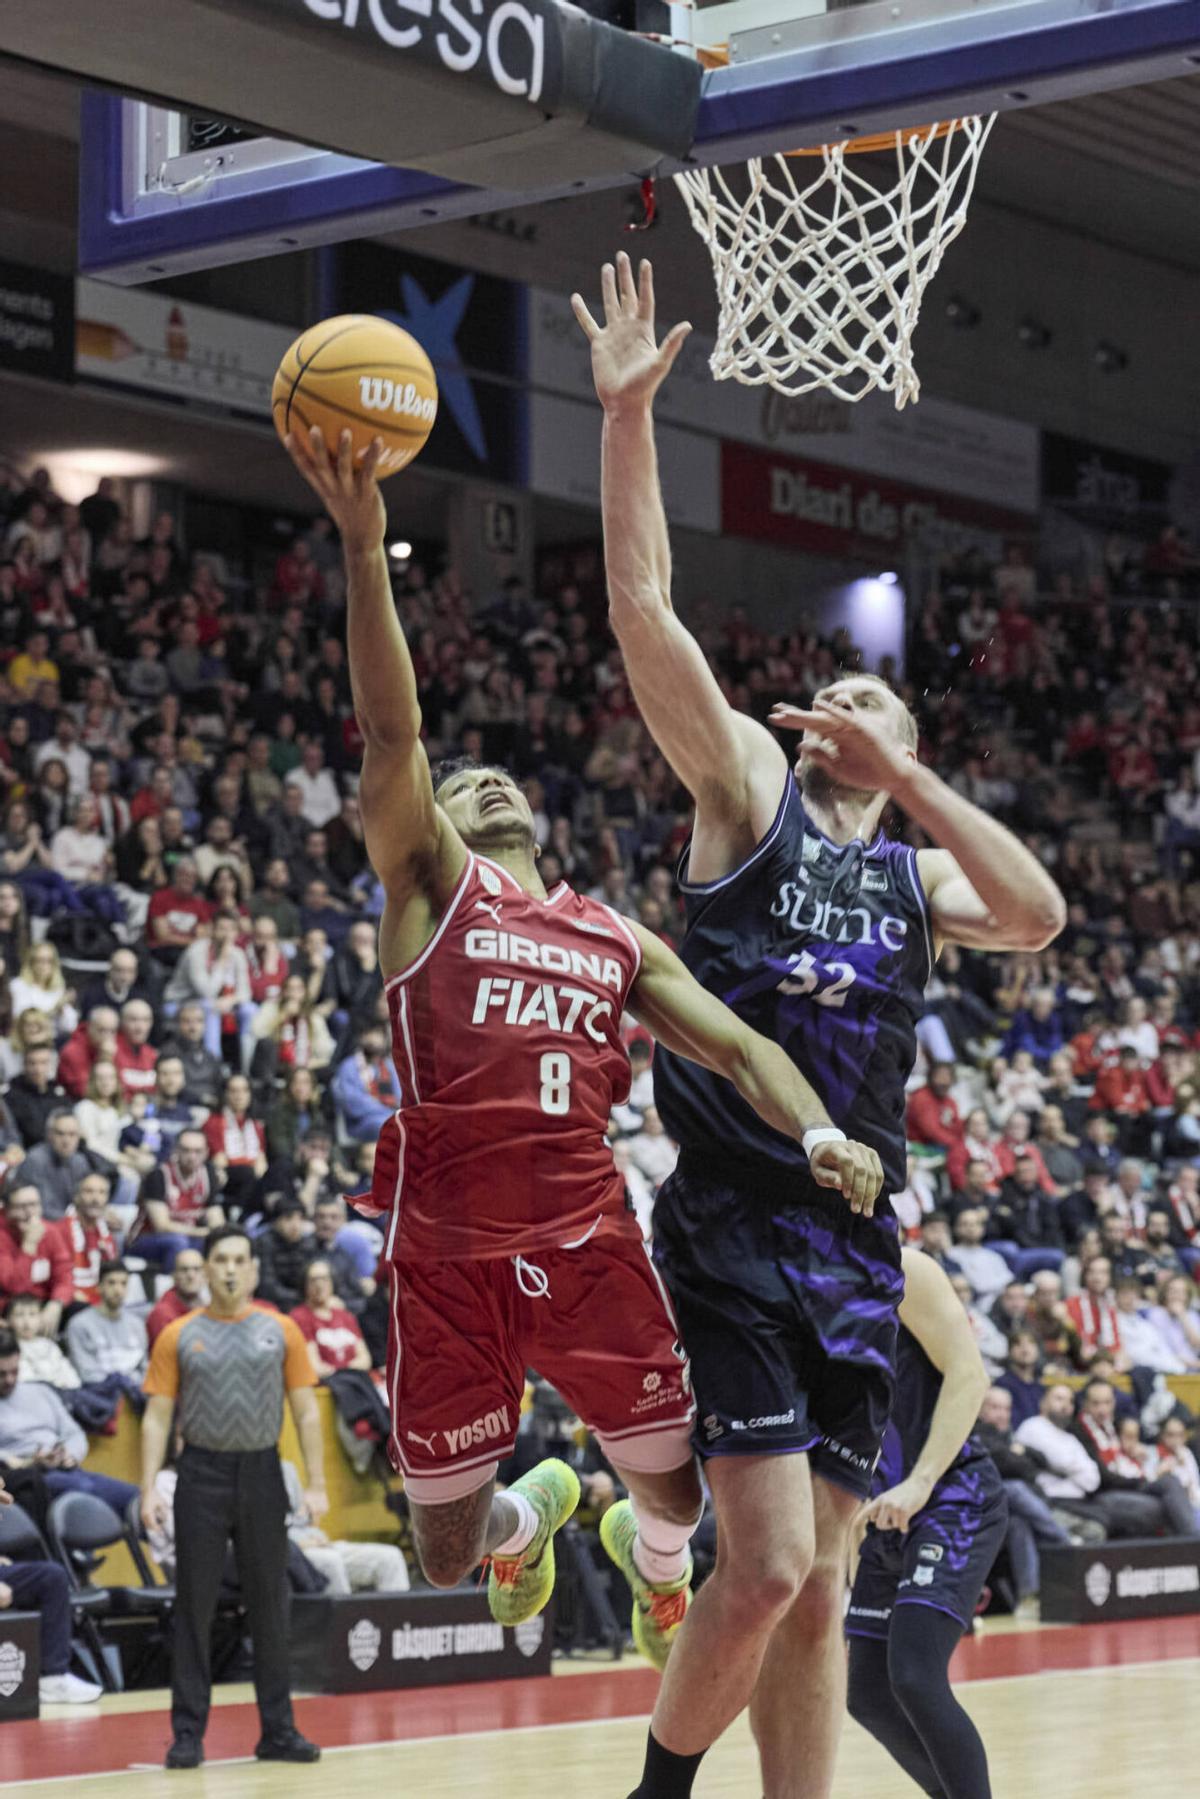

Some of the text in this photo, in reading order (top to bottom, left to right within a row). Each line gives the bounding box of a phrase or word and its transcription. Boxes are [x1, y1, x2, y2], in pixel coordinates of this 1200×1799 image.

[770, 467, 851, 528] Diari
[856, 490, 898, 540] de
[465, 929, 622, 993] GIRONA
[776, 949, 857, 1008] 32
[472, 977, 612, 1043] FIATC
[540, 1052, 571, 1116] 8
[443, 1405, 511, 1455] YOSOY
